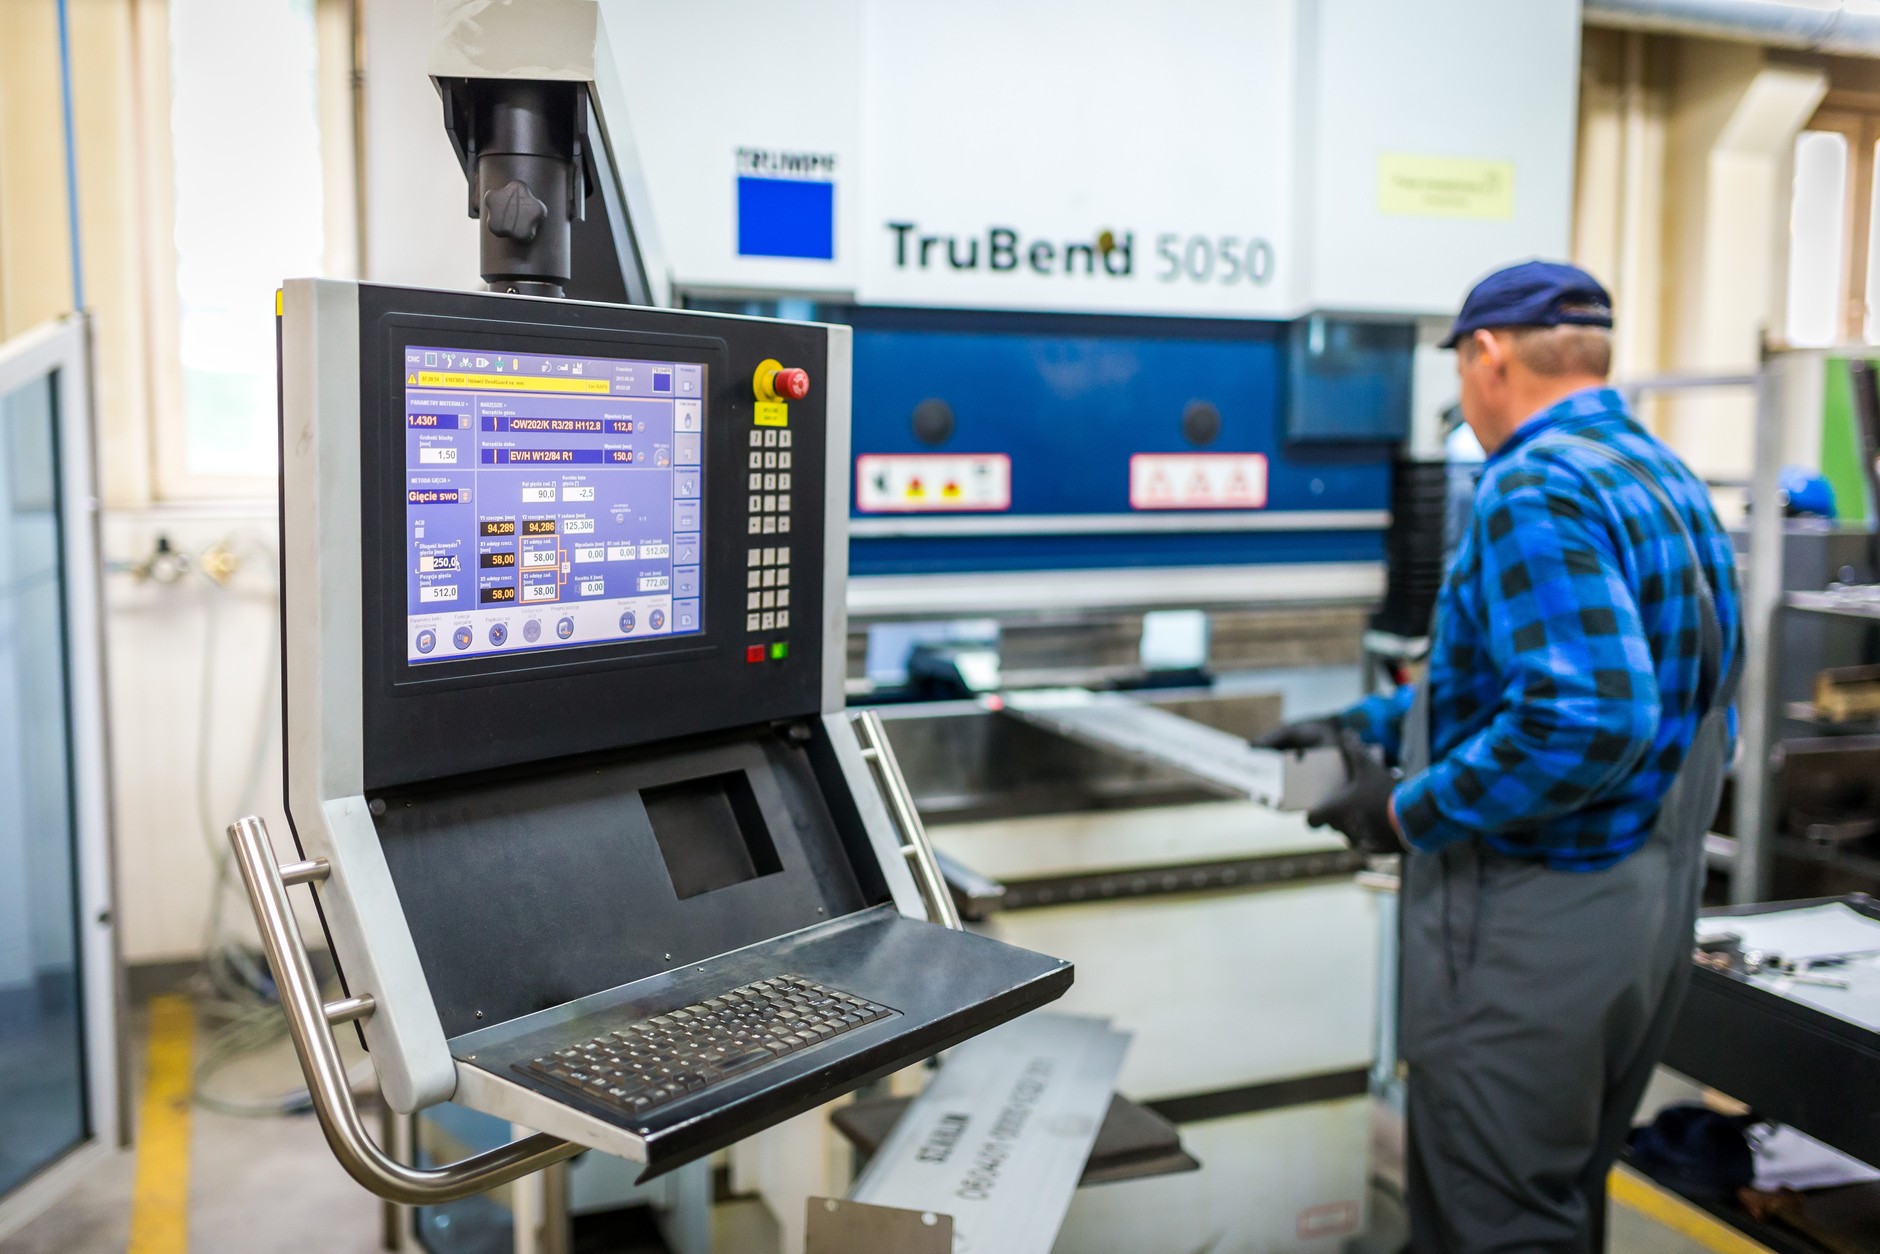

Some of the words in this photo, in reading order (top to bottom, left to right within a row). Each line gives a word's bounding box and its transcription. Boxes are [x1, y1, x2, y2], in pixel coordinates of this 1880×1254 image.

[886, 222, 1133, 276] TruBend
[1155, 233, 1275, 286] 5050
[409, 416, 437, 426] 1.4301
[510, 419, 550, 429] -OW202/K
[552, 421, 574, 430] R3/28
[575, 421, 601, 430] H112.8
[613, 422, 633, 431] 112,8
[438, 451, 456, 460] 1,50
[510, 451, 530, 460] EV/H
[532, 452, 561, 461] W12/84
[562, 452, 573, 460] R1
[613, 452, 633, 461] 150,0
[409, 492, 438, 503] Gięcie
[440, 493, 458, 501] swo
[538, 490, 554, 499] 90,0
[580, 490, 593, 498] -2,5
[488, 523, 514, 534] 94,289
[529, 522, 555, 532] 94,286
[534, 552, 554, 562] 58,00
[588, 550, 604, 559] 0,00
[620, 548, 634, 557] 0,00
[434, 558, 456, 568] 250,0
[492, 555, 514, 564] 58,00
[534, 586, 554, 596] 58,00
[588, 583, 603, 592] 0,00
[434, 588, 456, 598] 512,0
[492, 590, 514, 599] 58,00
